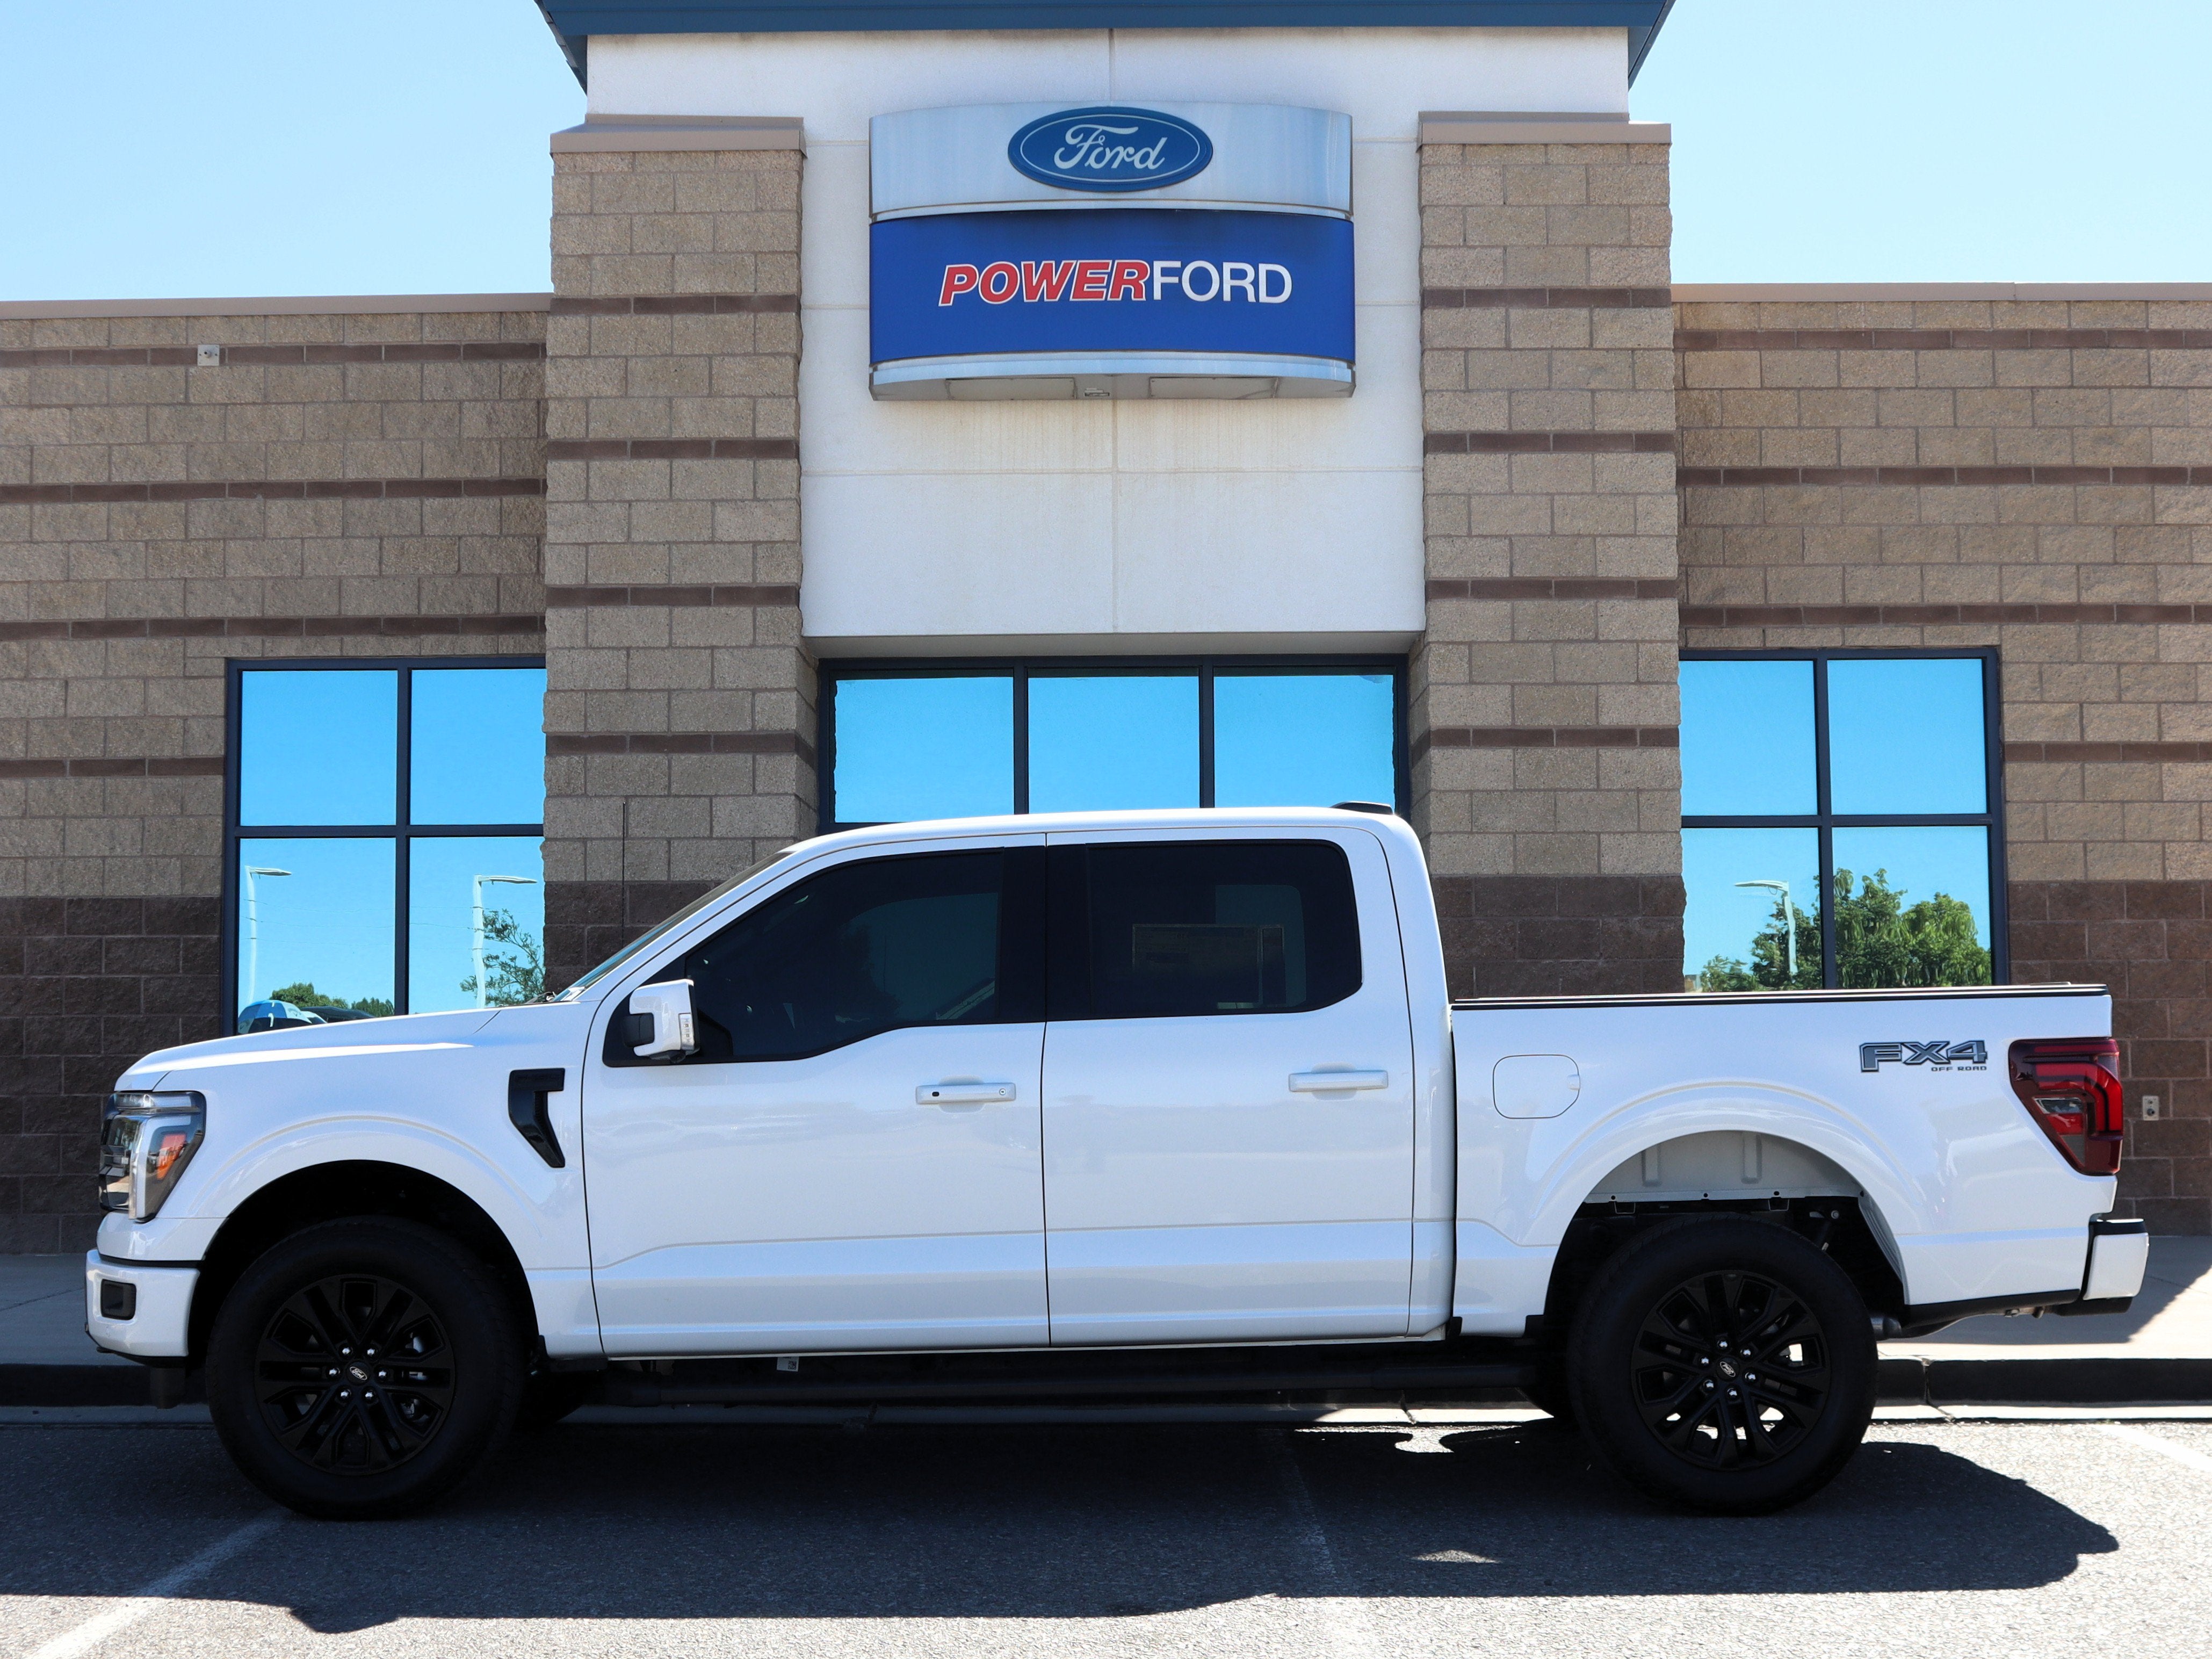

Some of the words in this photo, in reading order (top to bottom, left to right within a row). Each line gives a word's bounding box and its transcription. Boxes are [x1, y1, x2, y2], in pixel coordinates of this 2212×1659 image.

[1054, 124, 1168, 170] Ford
[1859, 1040, 1988, 1073] FX4
[351, 1368, 365, 1379] Ford
